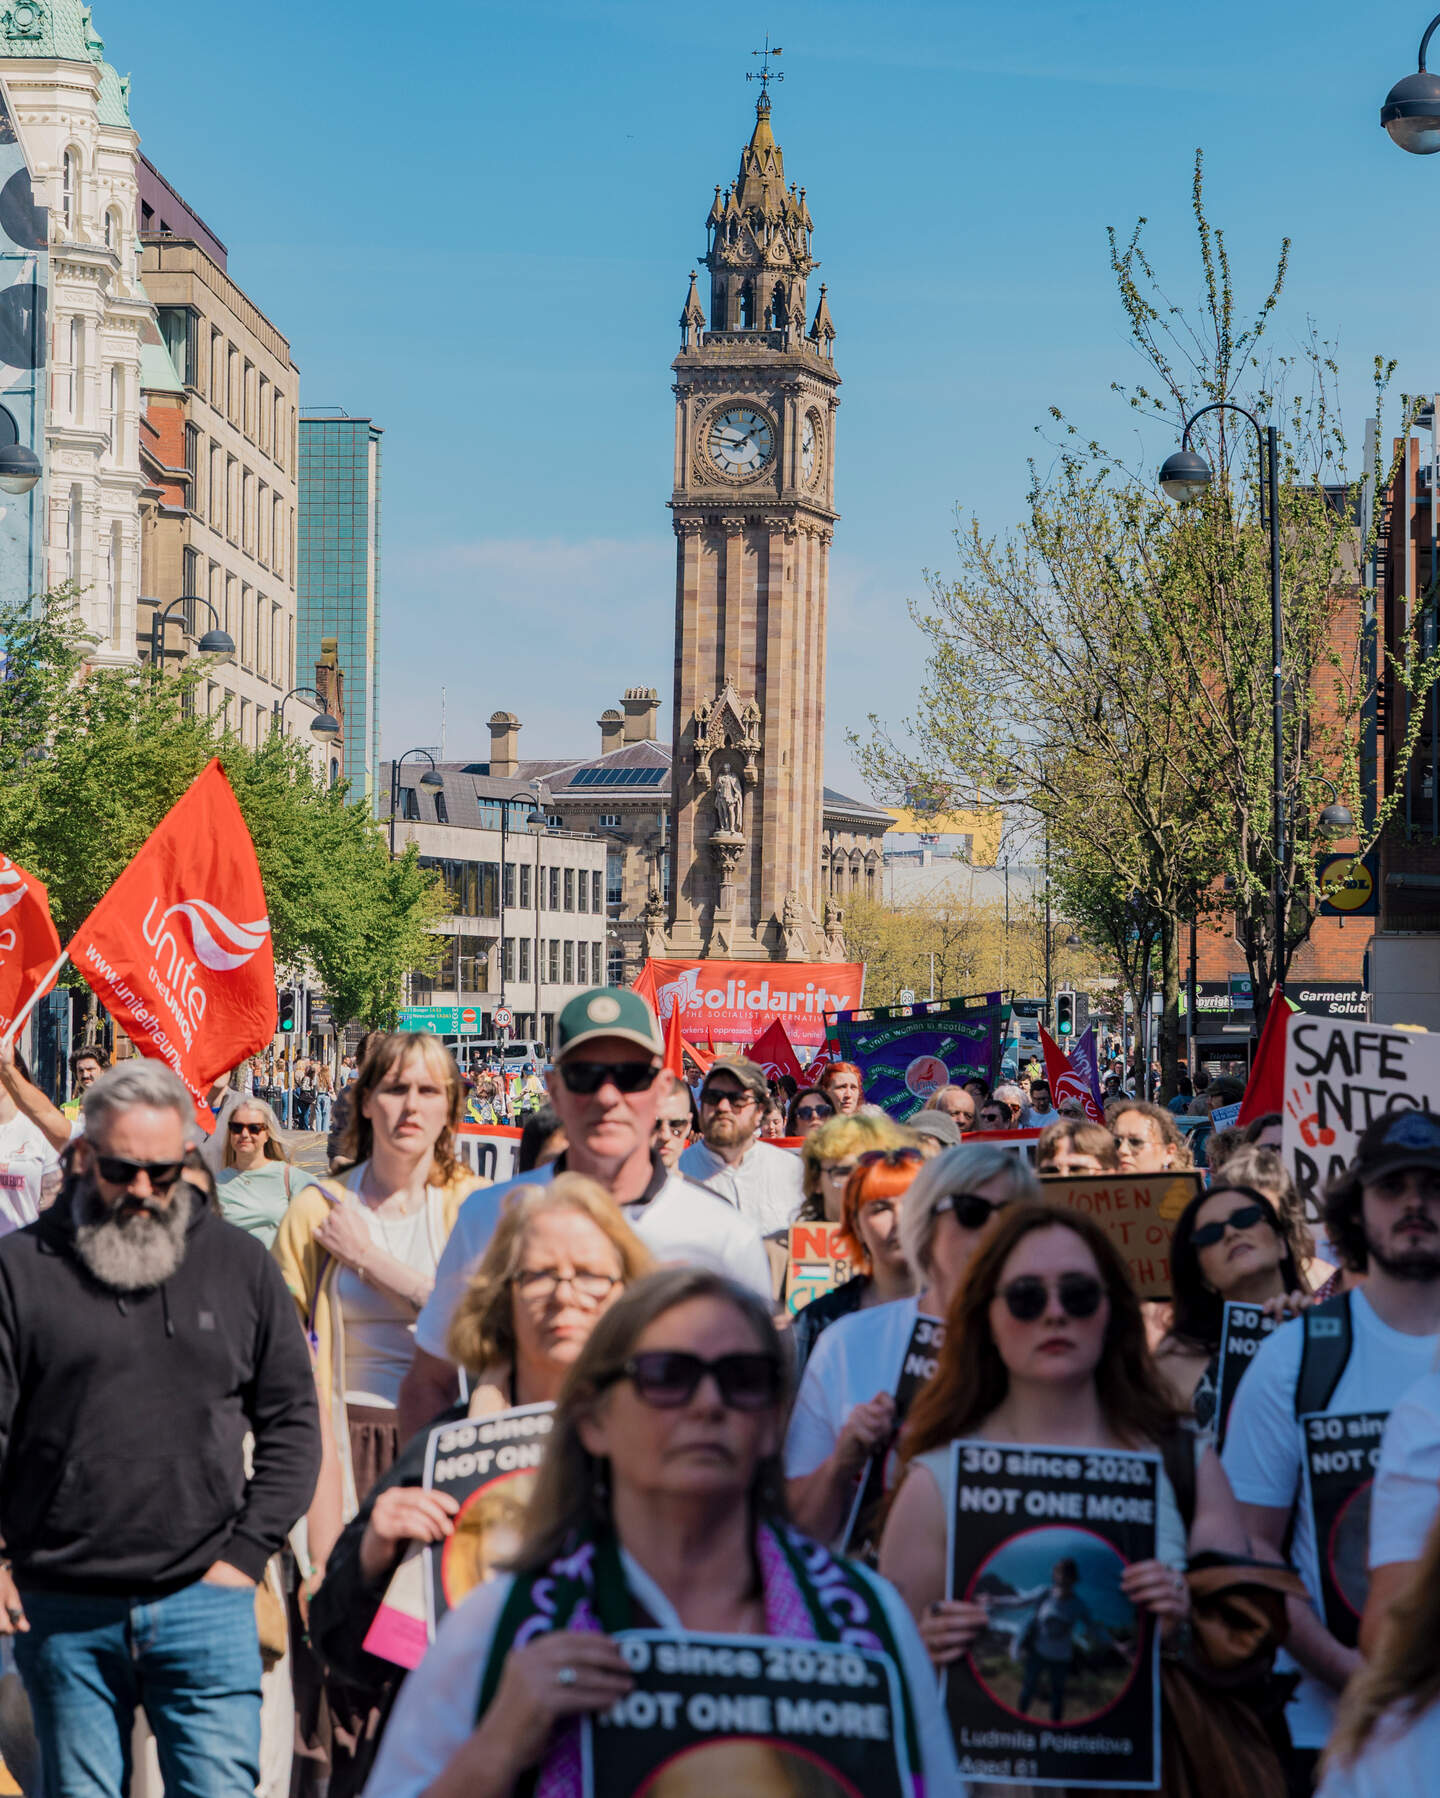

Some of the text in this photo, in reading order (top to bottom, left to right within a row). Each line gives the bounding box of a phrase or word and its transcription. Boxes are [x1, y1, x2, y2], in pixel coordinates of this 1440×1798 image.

[688, 979, 851, 1023] solidarity
[1299, 991, 1356, 1002] Garment
[497, 1013, 509, 1022] 30
[679, 1026, 704, 1035] orkers
[713, 1027, 752, 1036] oppressed
[686, 1010, 823, 1023] THE SOCIALIST ALTERNATIV
[1292, 1024, 1408, 1081] SAFE
[1231, 1309, 1259, 1330] 30
[436, 1414, 554, 1453] 30 since
[1308, 1418, 1342, 1441] 30
[434, 1447, 496, 1483] NOT
[962, 1449, 1001, 1474] 30
[1005, 1453, 1079, 1479] since
[1311, 1450, 1363, 1474] NOT
[959, 1486, 1154, 1524] NOT ONE MORE
[655, 1637, 762, 1679] since
[687, 1693, 773, 1733] ONE
[775, 1699, 891, 1741] MORE
